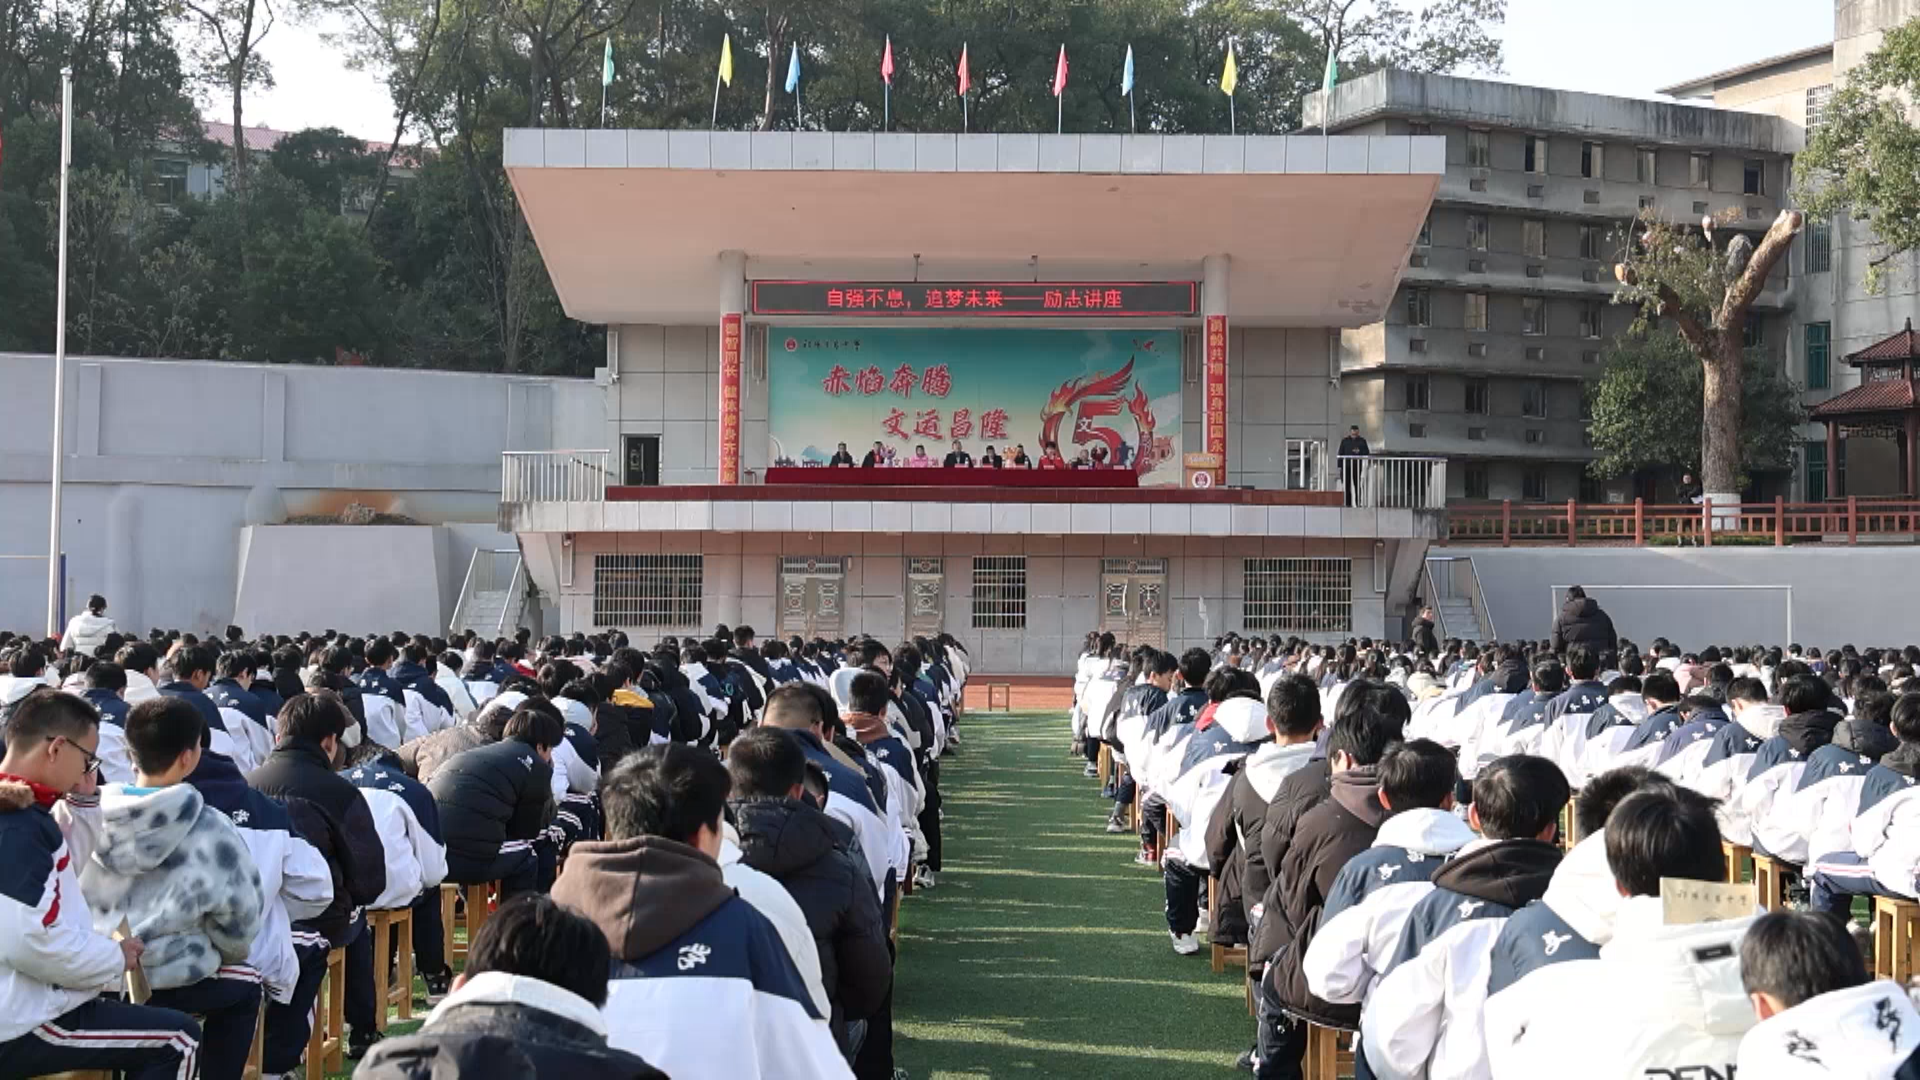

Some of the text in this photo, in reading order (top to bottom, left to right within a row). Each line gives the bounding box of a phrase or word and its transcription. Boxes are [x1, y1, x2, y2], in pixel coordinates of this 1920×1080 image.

[822, 362, 952, 399] 赤焰奔腾
[882, 407, 1009, 440] 文运昌隆
